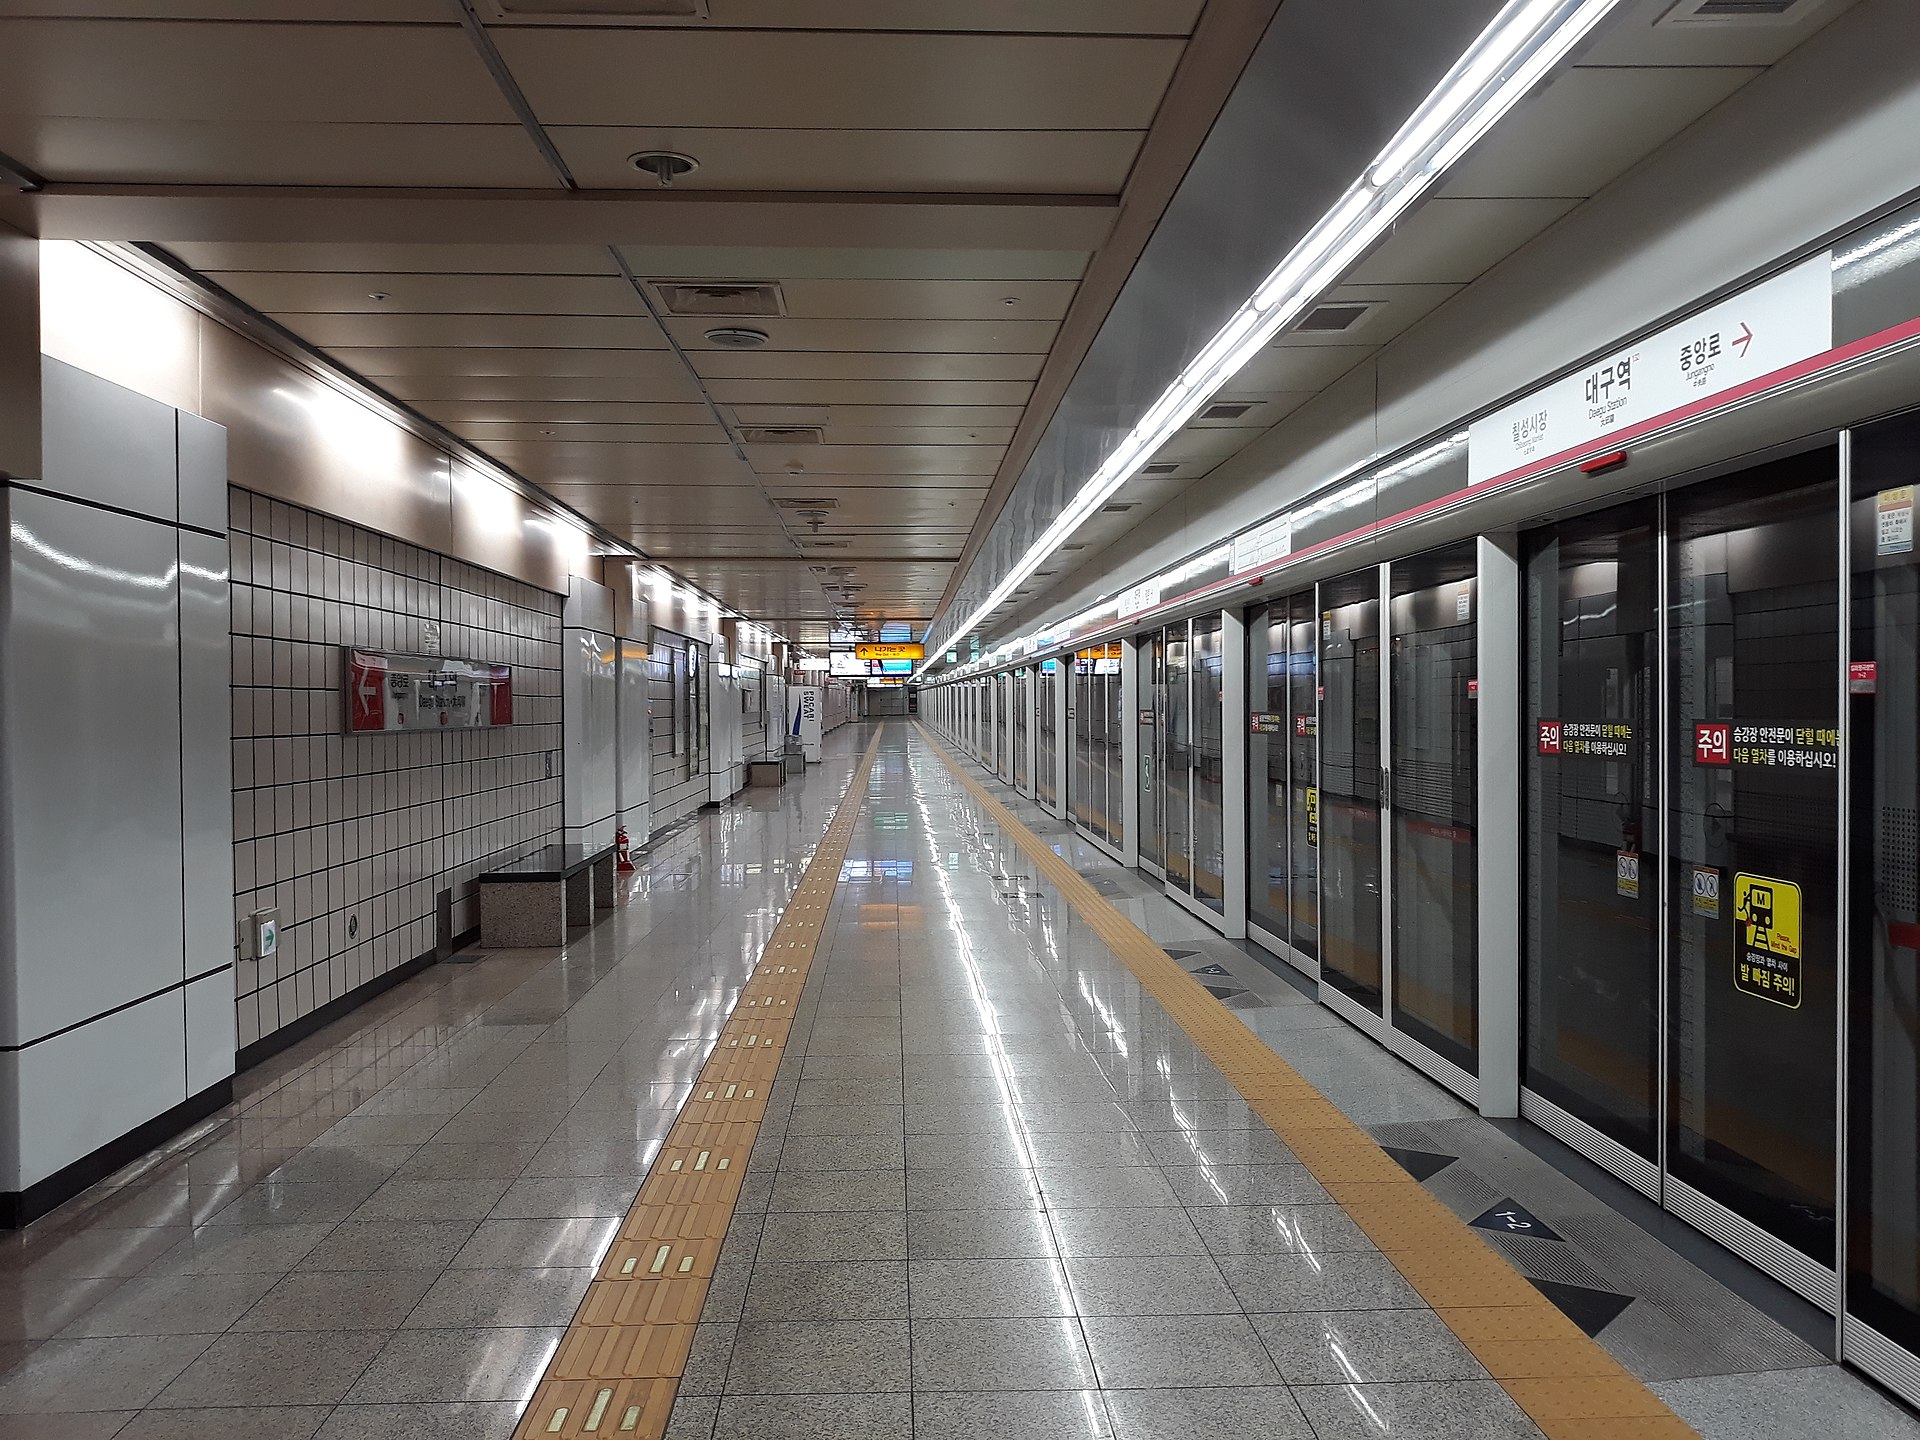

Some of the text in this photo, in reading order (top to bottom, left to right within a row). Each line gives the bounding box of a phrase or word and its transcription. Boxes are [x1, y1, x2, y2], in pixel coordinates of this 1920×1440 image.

[1680, 333, 1721, 371] 중앙로
[1585, 357, 1631, 404] 대구역
[1588, 396, 1628, 419] Daegu Station
[1512, 409, 1547, 442] 칠성시장
[1540, 725, 1559, 750] 주의
[1563, 723, 1579, 737] 승강장
[1579, 724, 1601, 738] 안전문이
[1733, 726, 1758, 743] 승강장
[1759, 727, 1794, 745] 안전문이
[1795, 728, 1814, 745] 닫힐
[1563, 740, 1627, 756] 다음 열차를 이용하십시오!
[1697, 728, 1727, 760] 주의
[1733, 747, 1837, 769] 다음 열차를 이용하십시오!
[1757, 892, 1765, 905] M
[1788, 945, 1798, 954] Gap
[1740, 963, 1795, 997] 발 빠짐 주의!
[1495, 1211, 1531, 1230] 1-2
